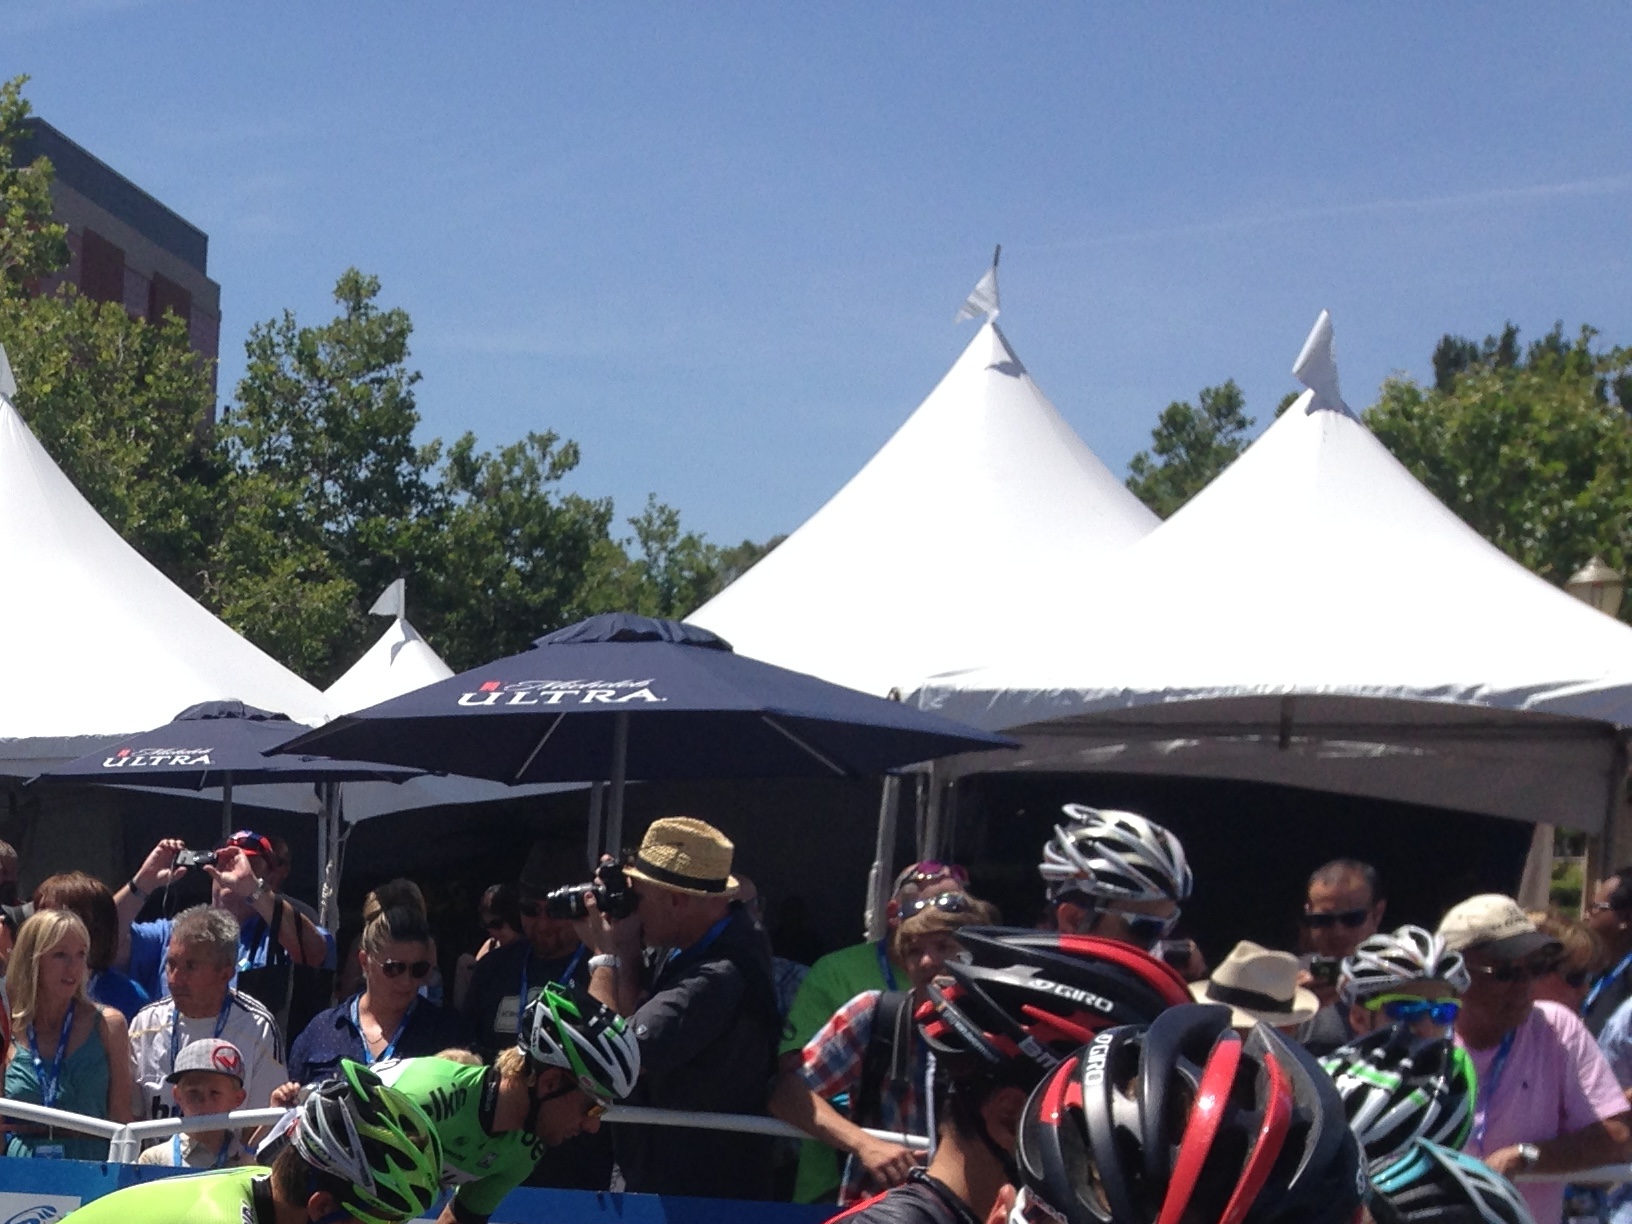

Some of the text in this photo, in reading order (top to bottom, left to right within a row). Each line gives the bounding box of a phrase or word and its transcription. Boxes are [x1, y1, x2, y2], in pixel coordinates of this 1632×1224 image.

[458, 688, 664, 706] ULTRA
[102, 755, 212, 768] ULTRA
[1055, 985, 1114, 1013] GIRO
[1019, 1035, 1059, 1068] BM
[1085, 1043, 1109, 1085] GIRO
